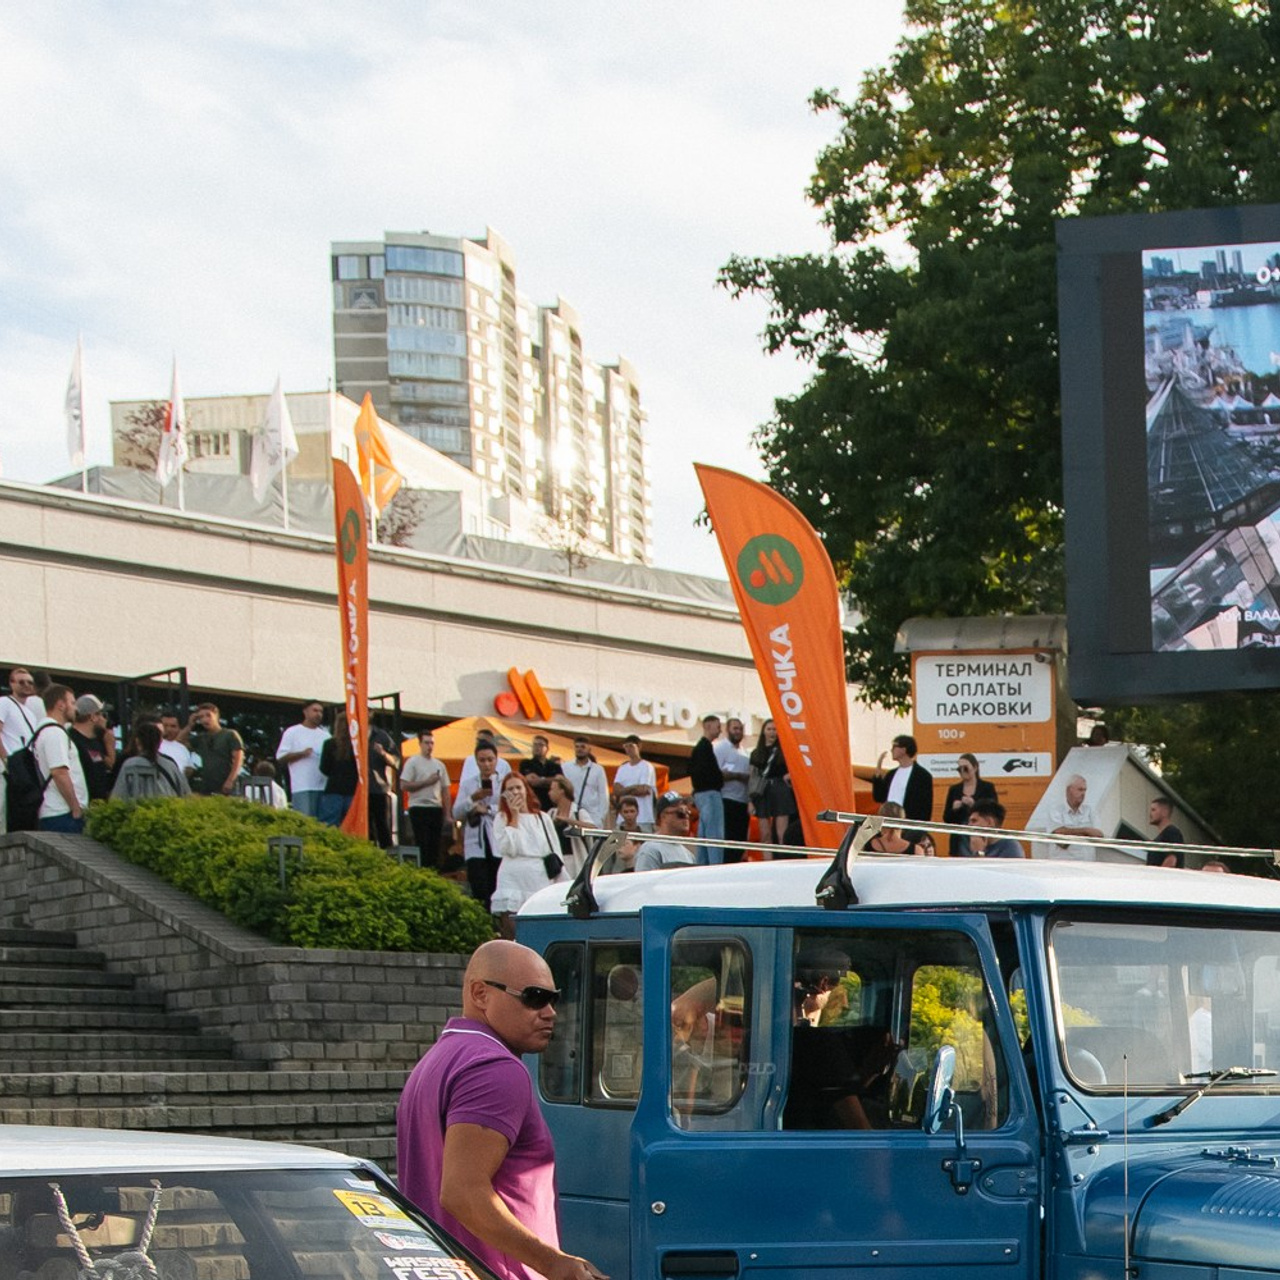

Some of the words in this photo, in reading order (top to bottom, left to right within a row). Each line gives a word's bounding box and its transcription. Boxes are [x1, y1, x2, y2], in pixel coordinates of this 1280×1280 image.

[935, 662, 1032, 677] ТЕРМИНАЛ
[946, 682, 1022, 697] ОПЛАТЫ
[567, 684, 699, 729] ВКУСНО
[936, 701, 1032, 717] ПАРКОВКИ
[351, 1200, 386, 1217] 13
